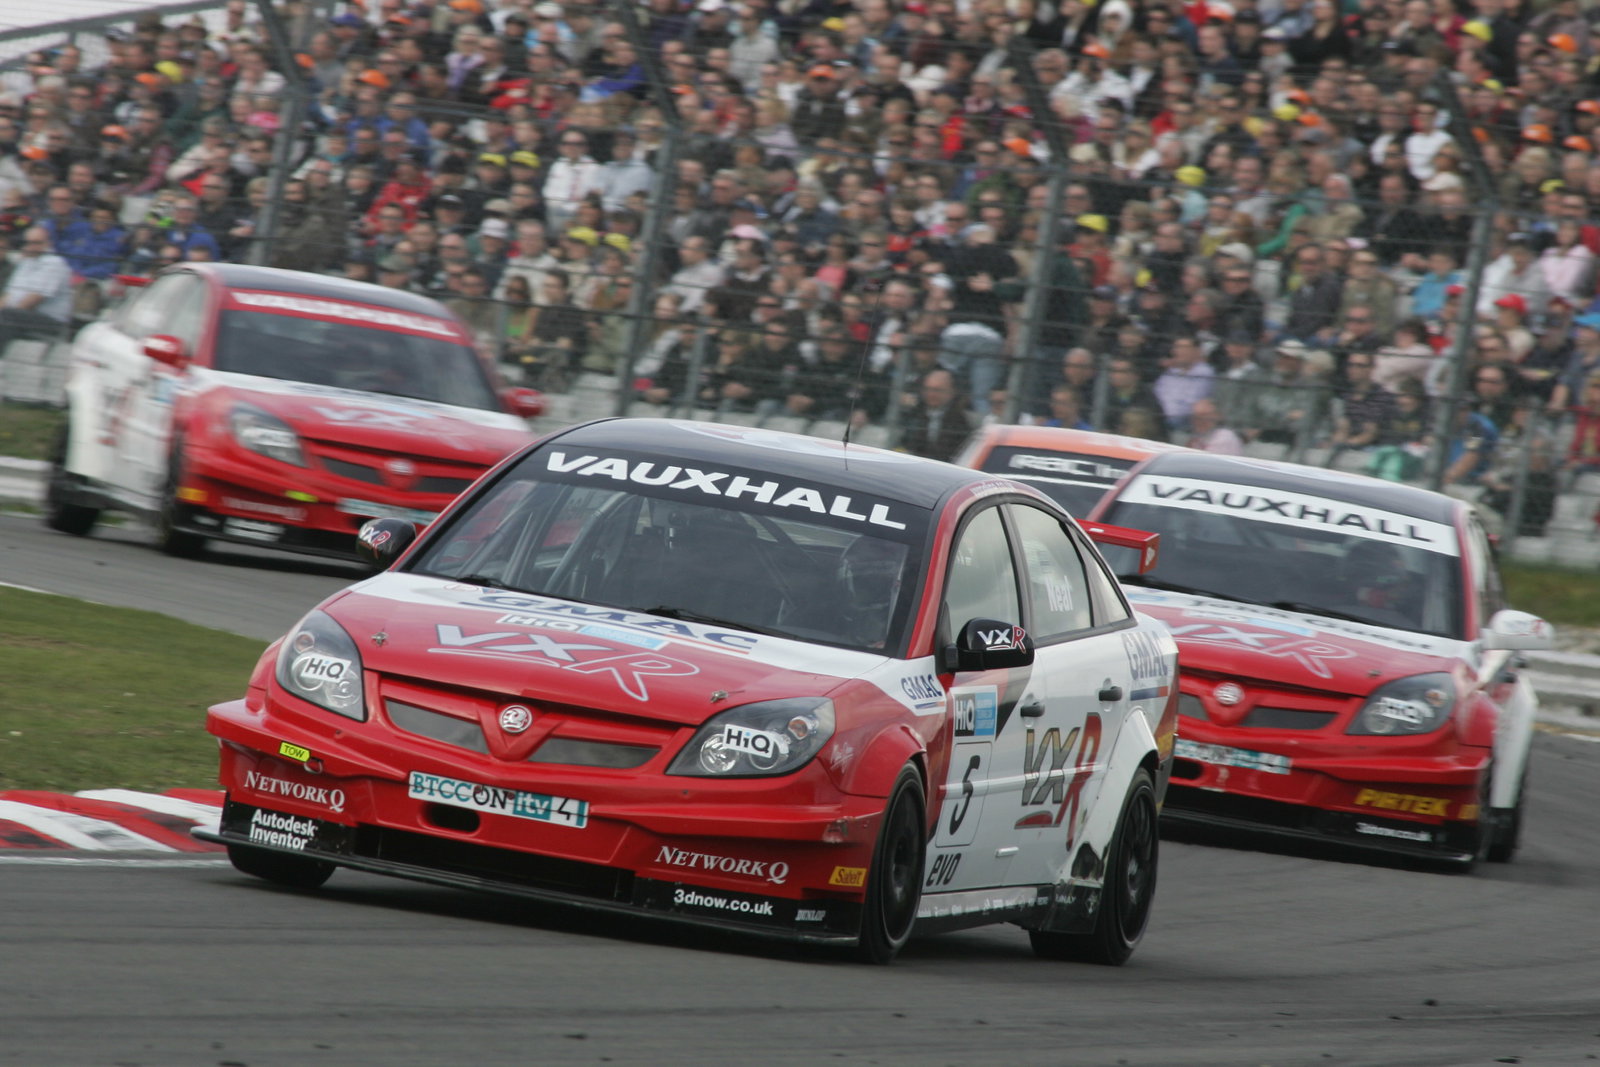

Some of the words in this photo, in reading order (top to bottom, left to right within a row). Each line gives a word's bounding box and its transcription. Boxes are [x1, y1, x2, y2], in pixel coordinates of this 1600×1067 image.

[545, 451, 907, 531] VAUXHALL
[1150, 482, 1437, 544] VAUXHALL
[359, 523, 391, 560] VXR
[479, 595, 758, 651] GMAC
[978, 625, 1027, 654] VXR
[434, 622, 701, 702] VXR
[1120, 630, 1169, 681] GMAC
[1156, 613, 1359, 680] VXR
[305, 655, 345, 681] HiQ
[900, 673, 944, 702] GMAC
[954, 698, 976, 731] HiQ
[284, 744, 306, 759] TOW
[725, 726, 772, 755] HiQ
[411, 772, 473, 803] BTCC
[516, 790, 550, 817] itv
[557, 796, 572, 821] 4
[949, 754, 983, 836] 5
[1020, 711, 1104, 852] VXR
[328, 788, 346, 814] Q
[249, 822, 309, 851] Inventor
[250, 808, 316, 838] Autodesk
[655, 845, 766, 879] NETWORK
[766, 860, 790, 885] Q
[925, 851, 963, 887] evo
[673, 887, 774, 917] 3dnow.co.uk
